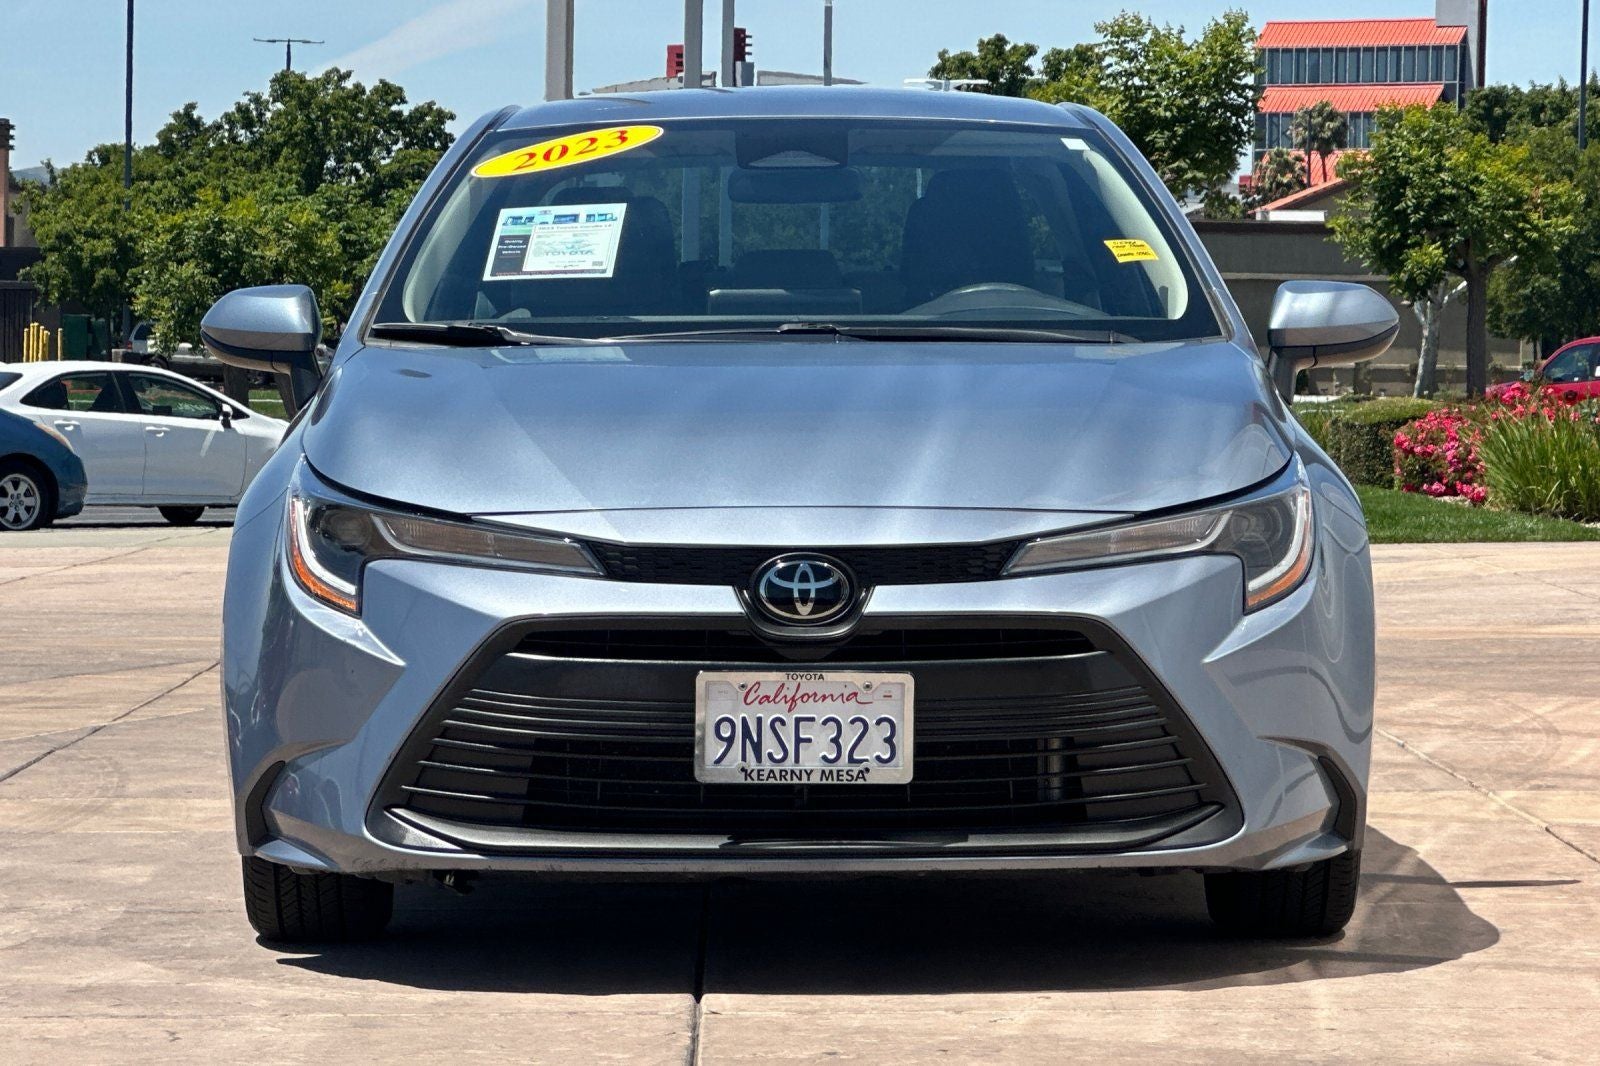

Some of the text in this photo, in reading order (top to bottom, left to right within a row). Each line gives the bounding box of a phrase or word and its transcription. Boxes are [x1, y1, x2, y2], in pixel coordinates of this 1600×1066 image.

[513, 130, 628, 170] 2023
[785, 673, 825, 681] TOYOTA
[743, 681, 873, 713] California
[713, 715, 897, 765] 9NSF323
[743, 768, 867, 782] KEARNY MESA
